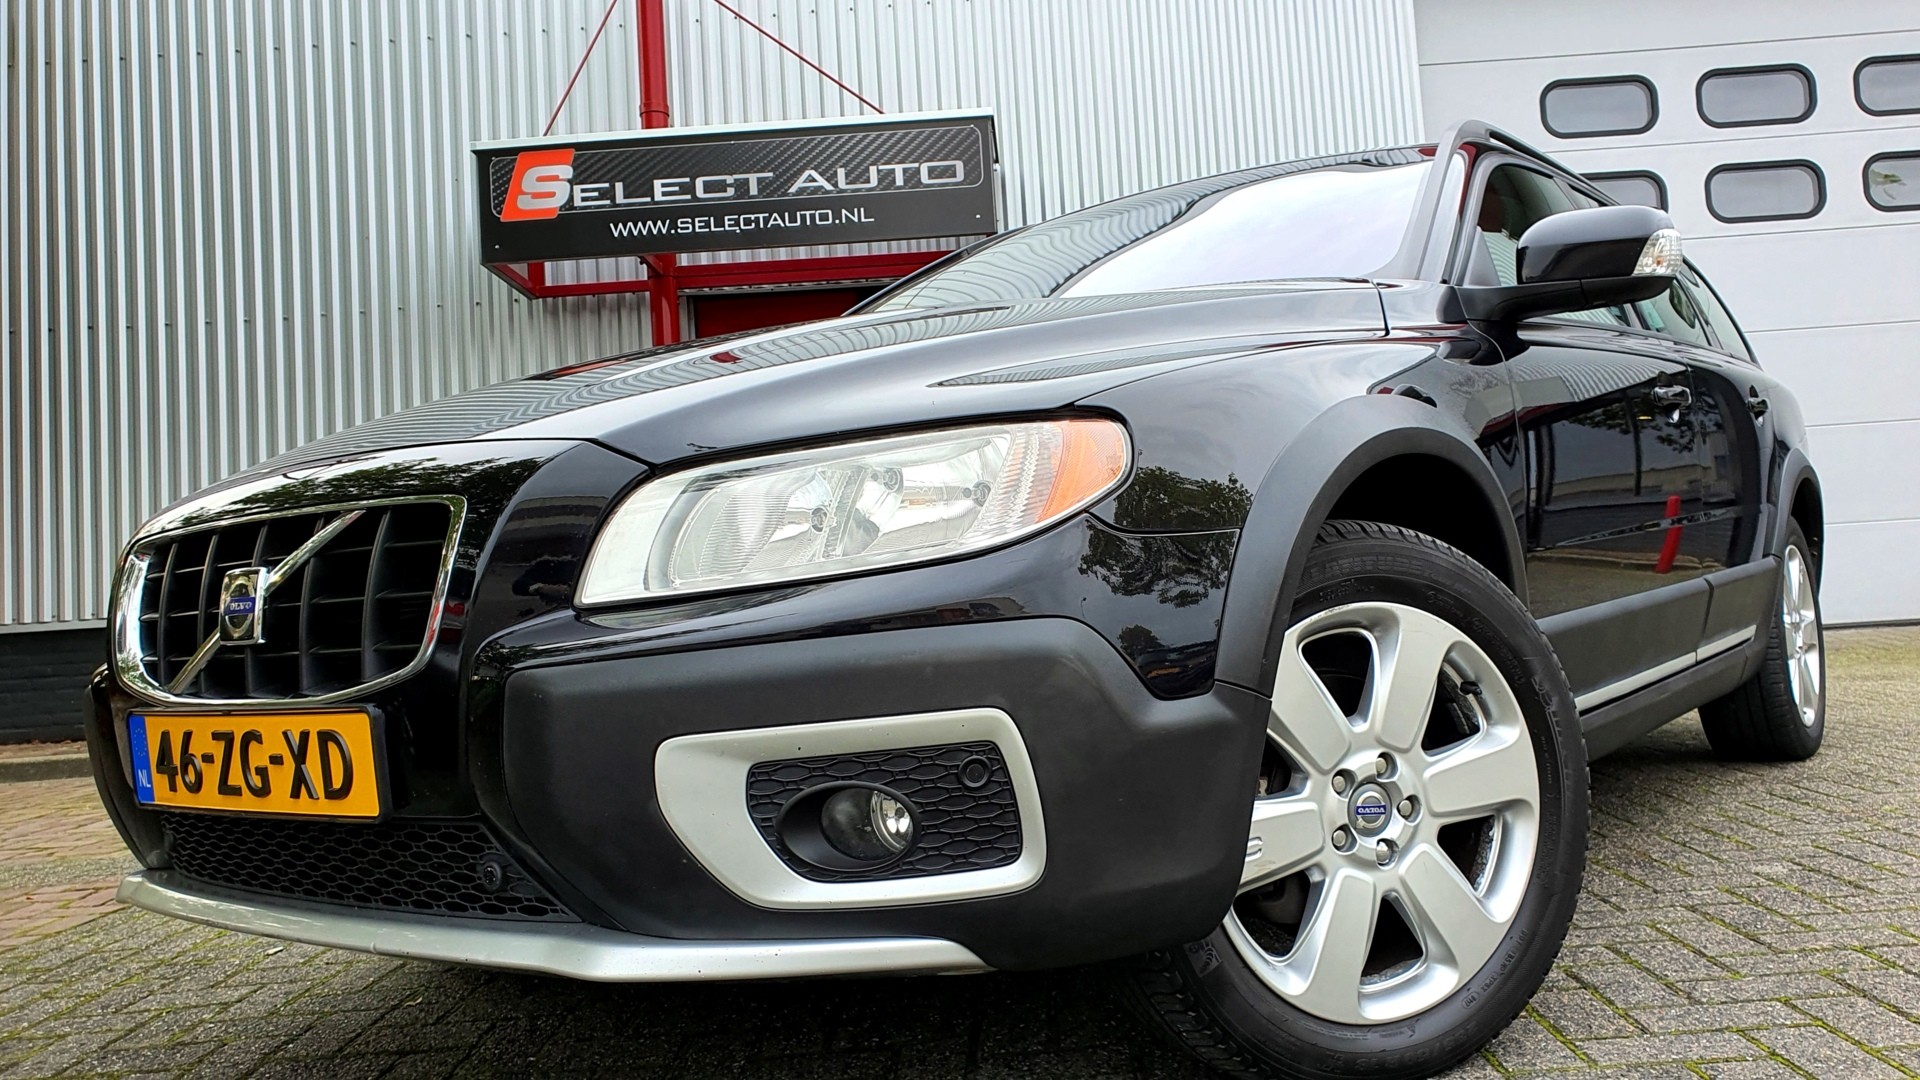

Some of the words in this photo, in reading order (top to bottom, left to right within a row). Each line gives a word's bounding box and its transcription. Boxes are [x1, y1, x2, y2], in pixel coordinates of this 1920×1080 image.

[516, 164, 774, 210] SELECT
[787, 160, 965, 194] AUTO
[609, 207, 875, 238] WWW.SELECTAUTO.NL
[138, 769, 152, 788] NL
[155, 729, 354, 801] 46-ZG-XD
